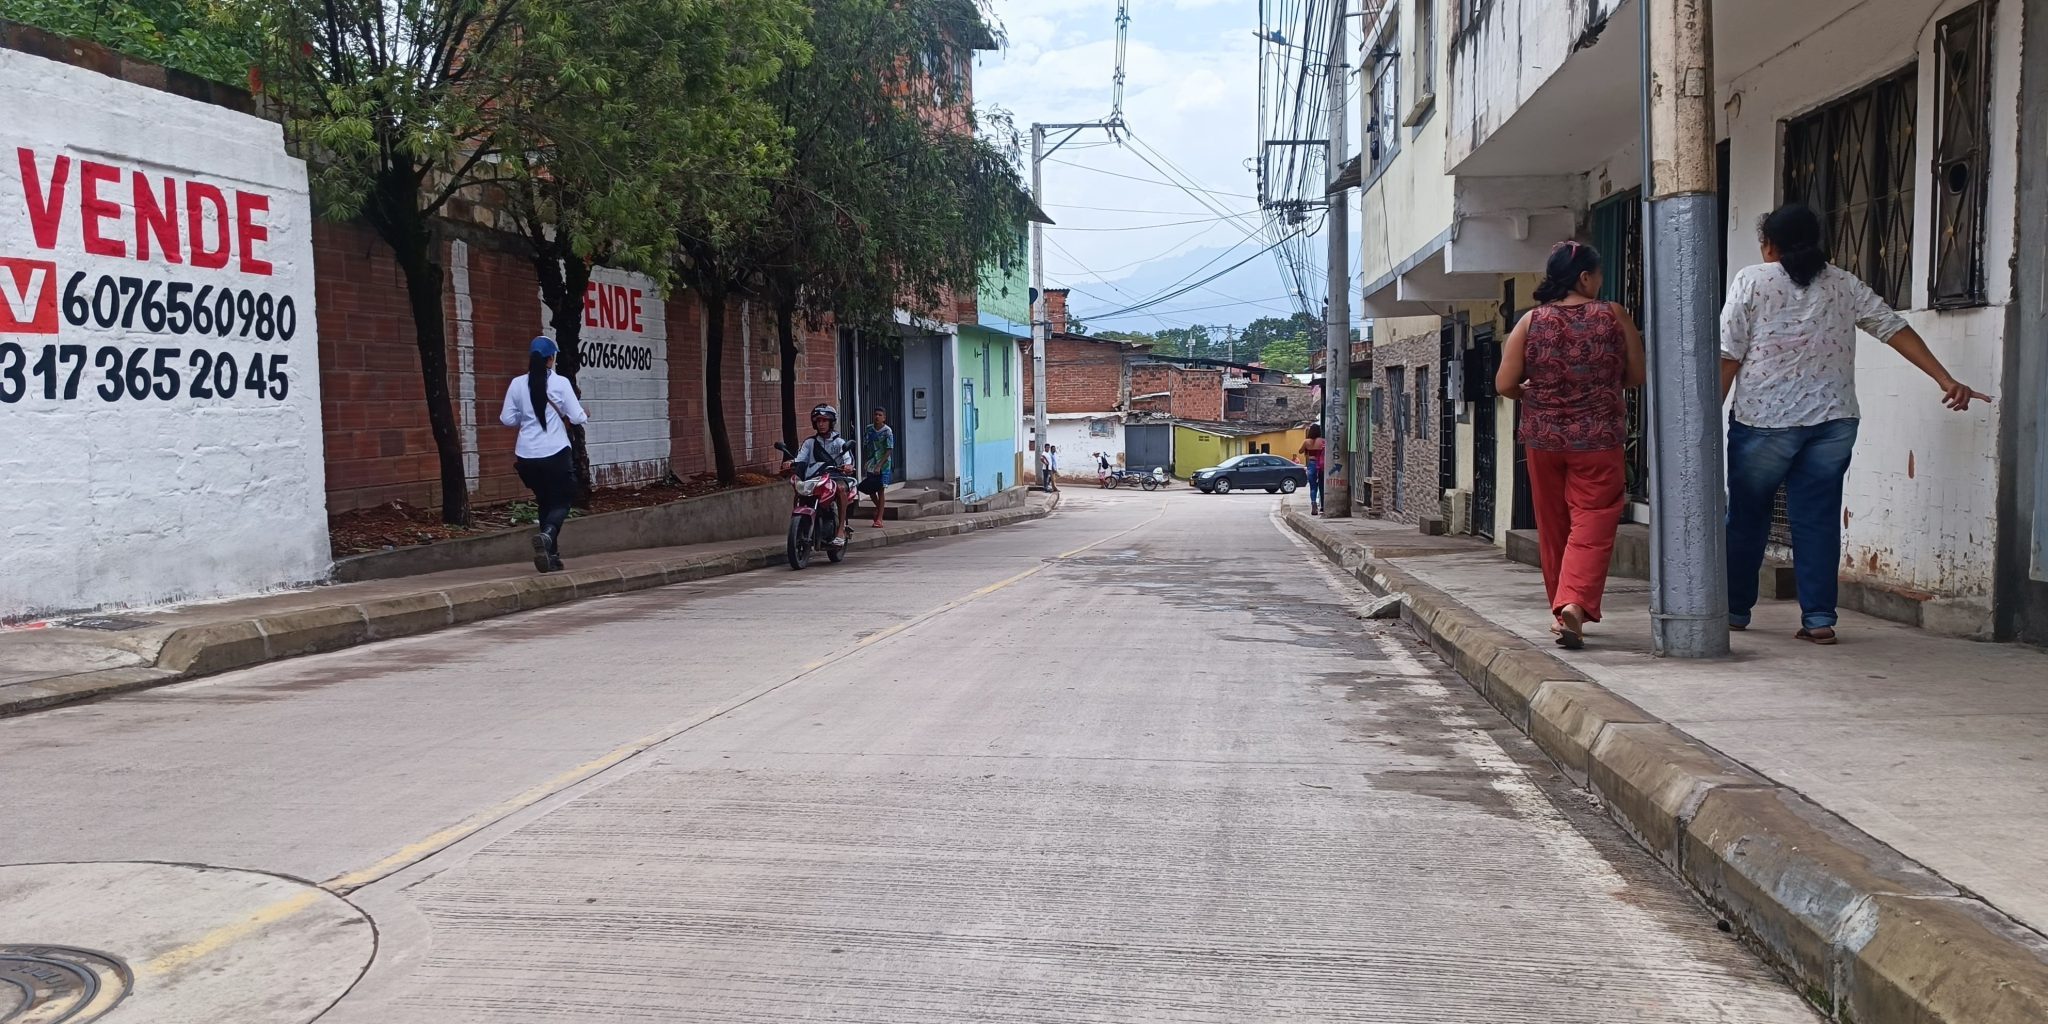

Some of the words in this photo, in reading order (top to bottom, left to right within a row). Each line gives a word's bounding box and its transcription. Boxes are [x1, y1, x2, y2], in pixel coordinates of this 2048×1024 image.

[17, 147, 273, 276] VENDE
[62, 271, 296, 341] 6076560980
[582, 281, 643, 333] ENDE
[0, 342, 87, 403] 317
[95, 346, 181, 402] 365
[189, 349, 238, 399] 20
[245, 352, 288, 401] 45
[580, 341, 652, 370] 6076560980
